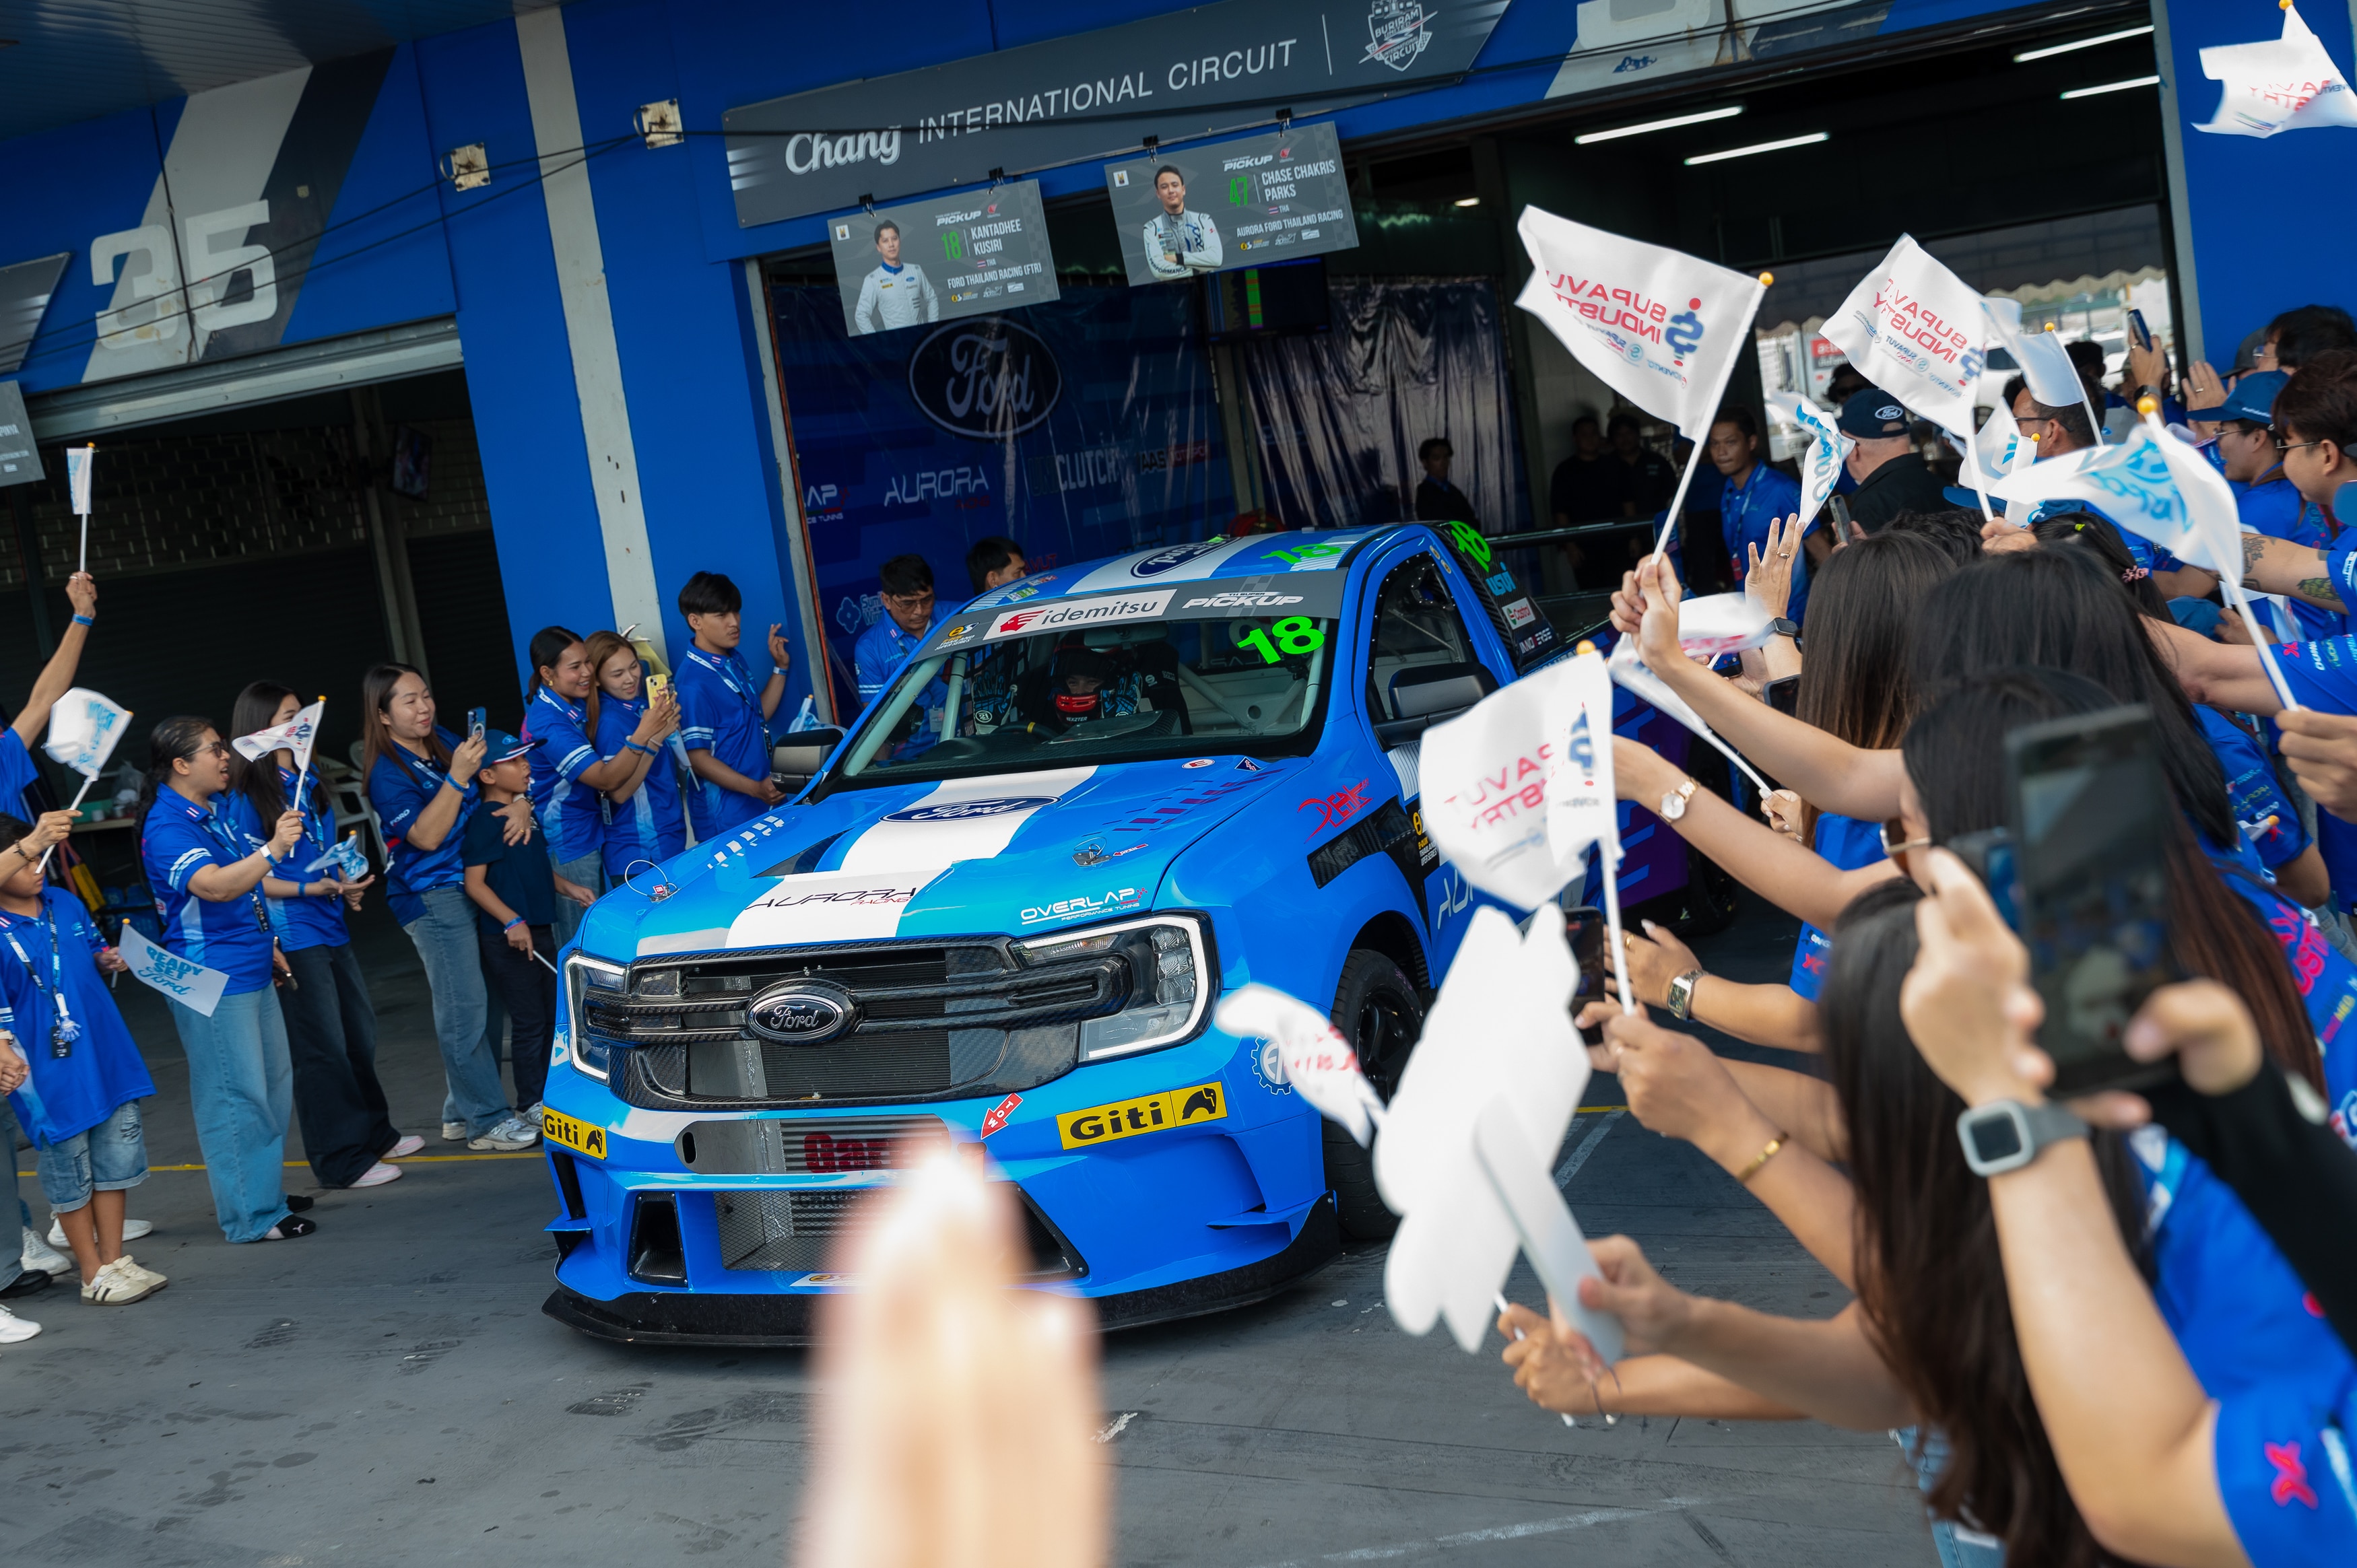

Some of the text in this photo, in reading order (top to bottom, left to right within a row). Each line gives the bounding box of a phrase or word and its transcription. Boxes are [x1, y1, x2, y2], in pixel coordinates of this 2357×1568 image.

[1374, 8, 1419, 38] BURIRAM
[1385, 41, 1420, 64] CIRCUIT
[785, 38, 1297, 174] Chang INTERNATIONAL CIRCUIT
[1224, 154, 1273, 172] PICKUP
[1261, 160, 1336, 186] CHASE CHAKRIS
[1229, 176, 1248, 207] 47
[1264, 183, 1296, 202] PARKS
[937, 210, 981, 226] PICKUP
[1279, 205, 1290, 213] THA
[970, 218, 1022, 240] KANTADHEE
[1236, 209, 1343, 238] AURORA FORD THAILAND RACING
[941, 231, 962, 261] 18
[973, 238, 1003, 256] KUSIRI
[90, 199, 277, 350] 35
[947, 262, 1042, 289] FORD THAILAND RACING (FTR)
[987, 258, 997, 267] THA
[946, 334, 1034, 418] Ford
[884, 465, 989, 507] AURORA
[1259, 543, 1342, 564] 18
[1450, 521, 1491, 572] 18
[1041, 599, 1158, 625] idemitsu
[1182, 595, 1304, 609] PICKUP
[1237, 615, 1325, 664] 18
[911, 800, 1027, 820] Ford
[1420, 840, 1437, 856] THAILAND
[745, 887, 917, 910] AURORA
[851, 897, 912, 906] RACING
[1020, 887, 1135, 920] OVERLAP
[1061, 902, 1139, 921] PERFORMANCE TUNING
[147, 945, 204, 976] READY
[154, 961, 187, 980] SET
[138, 966, 195, 995] Ford
[770, 1004, 819, 1029] Ford
[987, 1100, 1014, 1128] TOW
[1069, 1101, 1164, 1140] Giti
[544, 1114, 578, 1146] Giti
